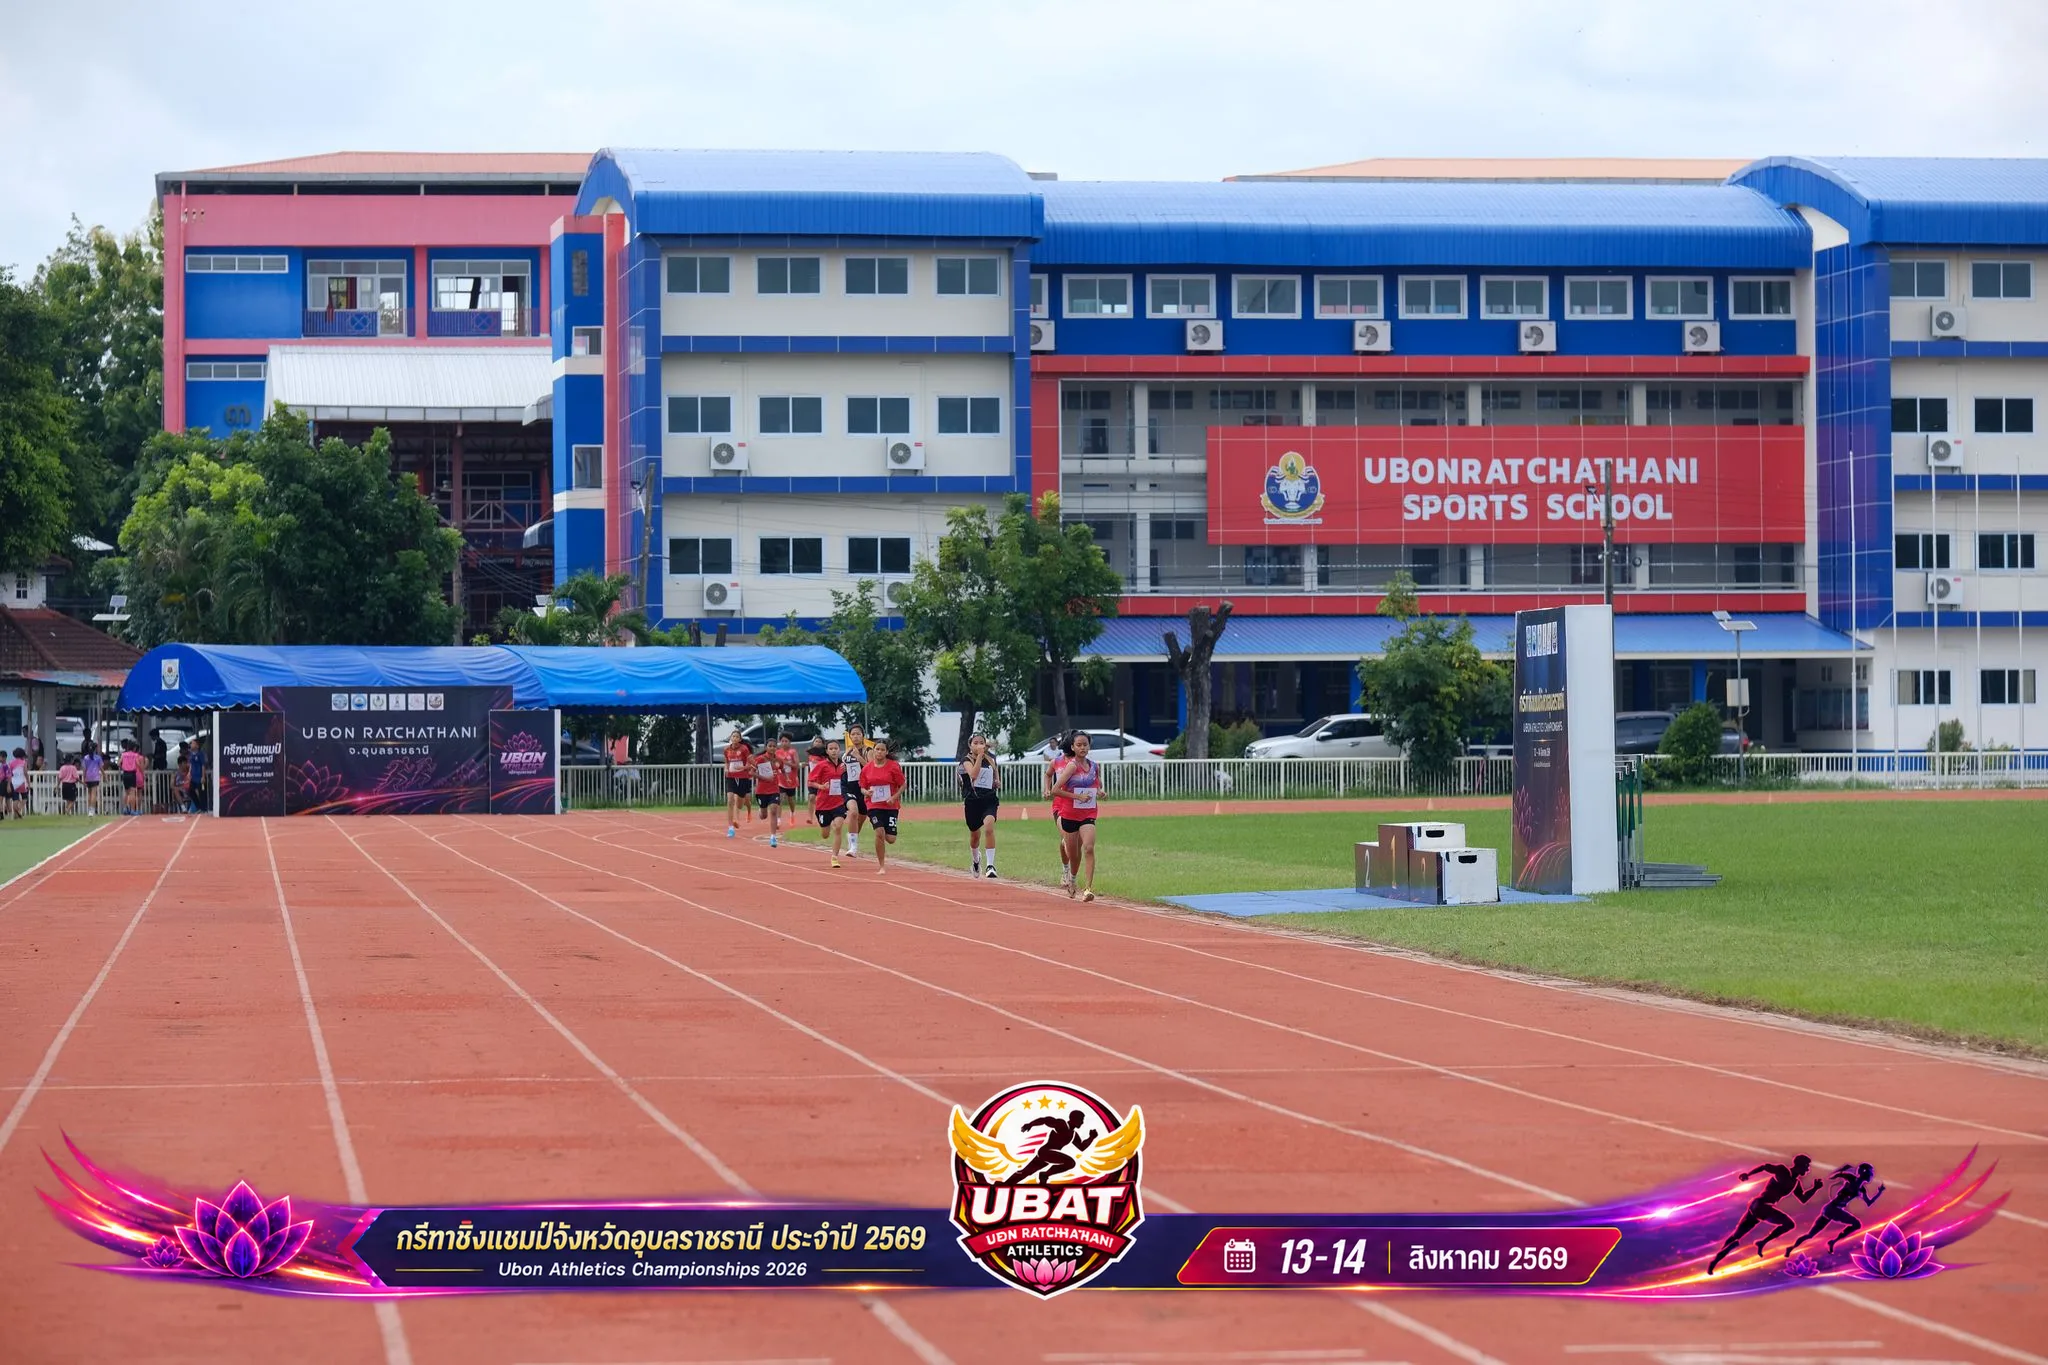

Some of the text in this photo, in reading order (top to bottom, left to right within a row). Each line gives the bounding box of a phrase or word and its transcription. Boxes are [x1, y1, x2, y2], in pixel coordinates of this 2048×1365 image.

[1364, 457, 1698, 485] UBONRATCHATHANI
[1403, 493, 1673, 521] SPORTS SCHOOL
[302, 726, 477, 739] UBON RATCHATHANI
[348, 745, 429, 758] จ.อุบลราชธานี
[500, 751, 547, 764] UBON
